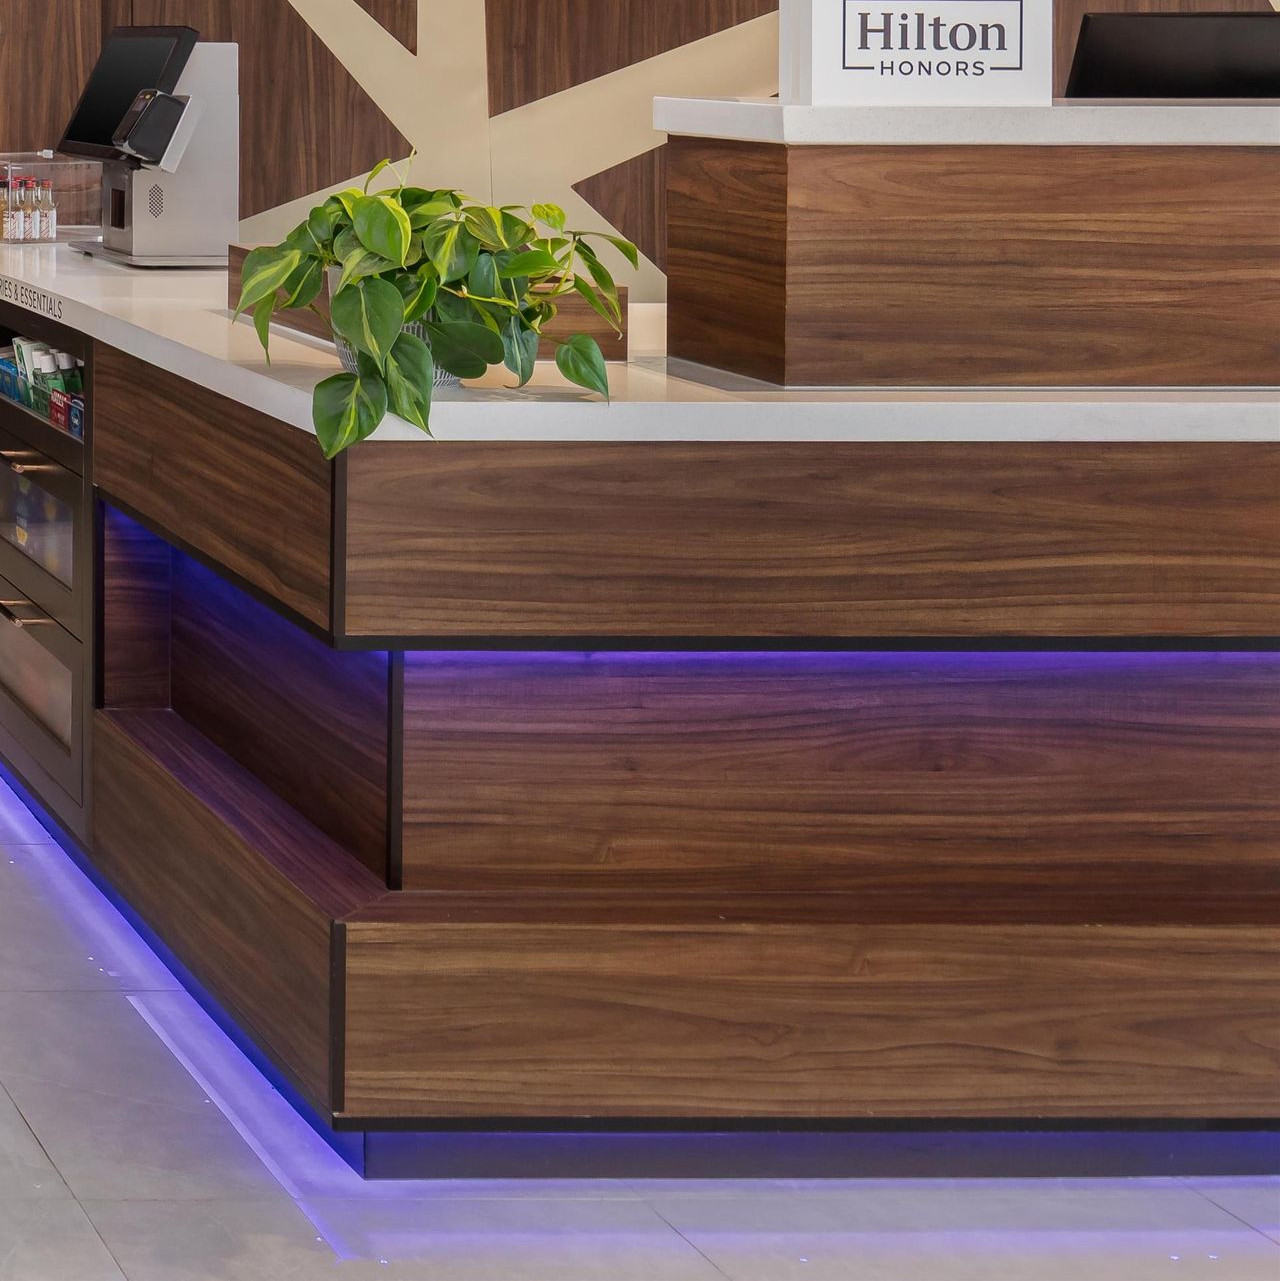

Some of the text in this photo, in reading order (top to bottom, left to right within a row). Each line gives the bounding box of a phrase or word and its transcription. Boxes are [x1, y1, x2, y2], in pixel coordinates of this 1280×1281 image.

[856, 12, 1008, 51] Hilton
[880, 60, 986, 77] HONORS
[13, 286, 19, 302] &
[20, 286, 64, 320] ESSENTIALS
